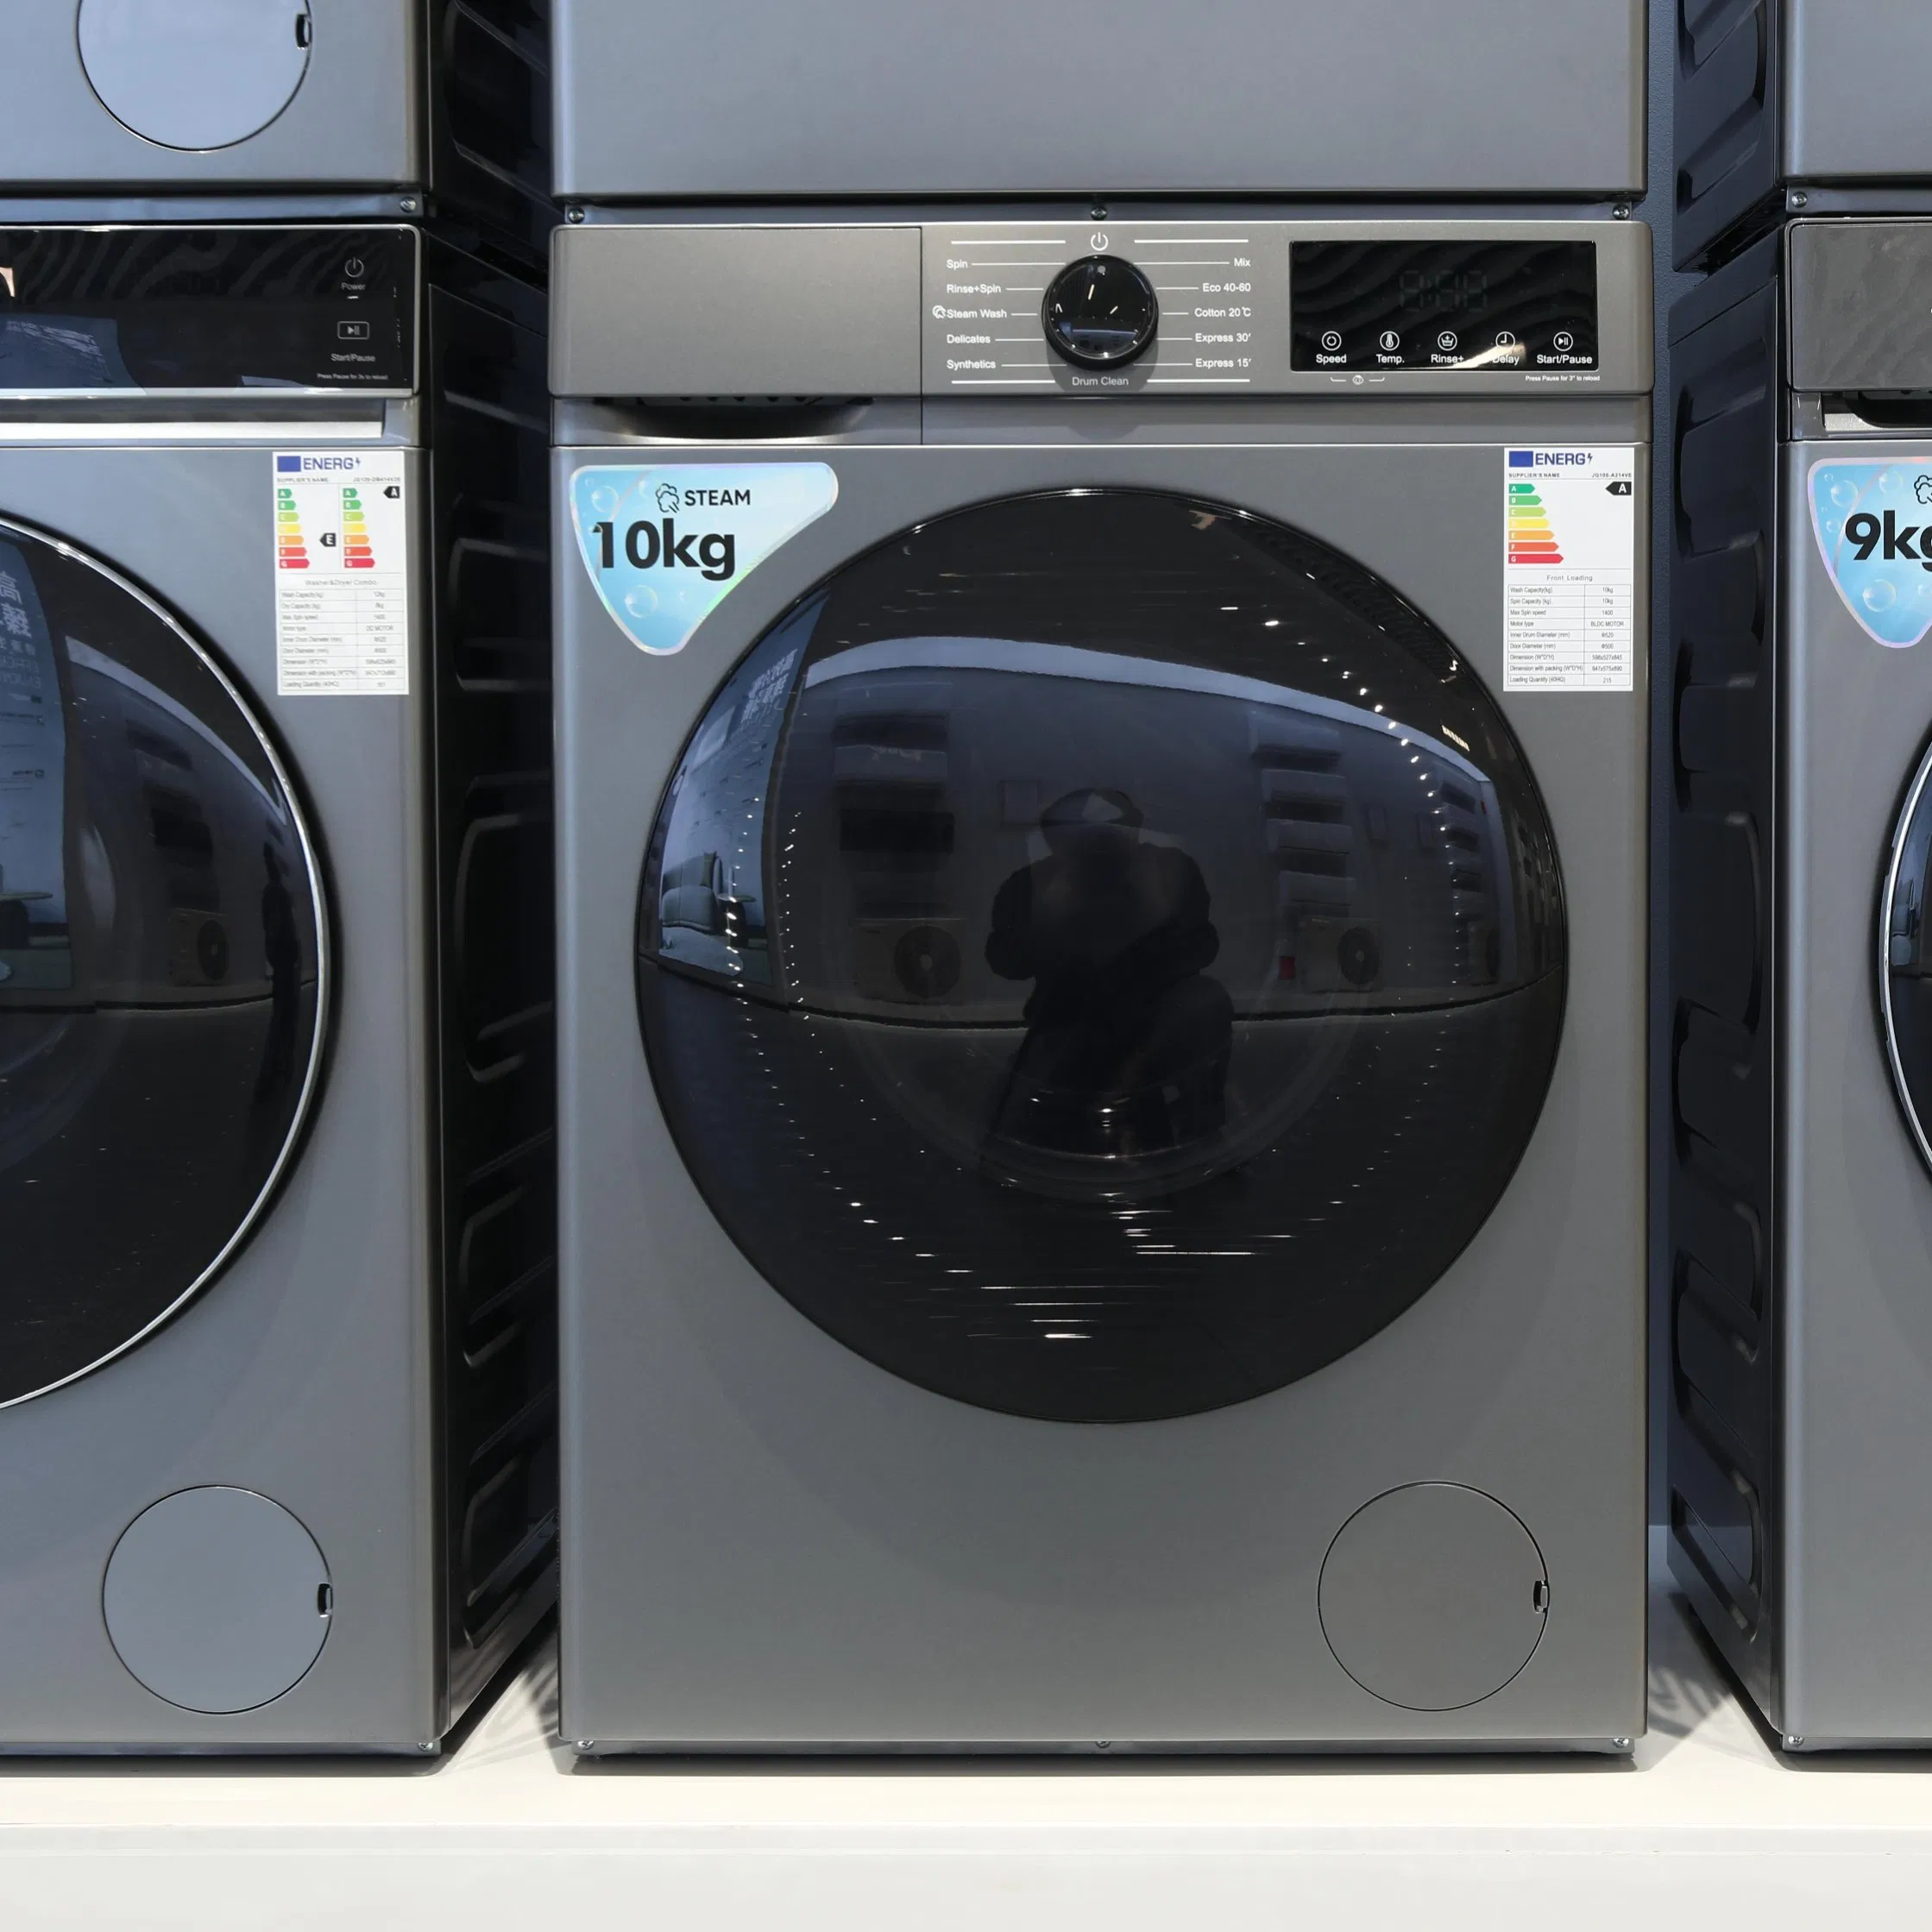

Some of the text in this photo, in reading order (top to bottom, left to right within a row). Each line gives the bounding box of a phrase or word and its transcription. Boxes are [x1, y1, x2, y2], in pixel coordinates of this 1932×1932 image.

[947, 260, 968, 269] Spin
[1234, 258, 1251, 267] Mix
[947, 285, 1001, 294] Rinse+Spin
[1203, 283, 1251, 292] Eco 40-60
[947, 309, 1008, 318] Steam Wash
[1194, 308, 1225, 318] Cotton
[947, 334, 991, 343] Delicates
[1195, 333, 1234, 343] Express
[330, 353, 376, 362] Start/Pause
[1316, 354, 1347, 364] Speed
[1375, 354, 1405, 364] Temp.
[1431, 354, 1463, 363] Rinse+
[1493, 355, 1520, 366] Delay
[1537, 354, 1593, 364] Start/Pause
[947, 359, 996, 371] Synthetics
[1195, 358, 1234, 369] Express
[1072, 376, 1129, 386] Drum Clean
[304, 457, 354, 469] ENERG
[1535, 453, 1586, 465] ENERG
[391, 488, 398, 497] A
[1619, 483, 1627, 493] A
[684, 489, 751, 506] STEAM
[326, 535, 333, 544] E
[593, 518, 735, 582] 10kg
